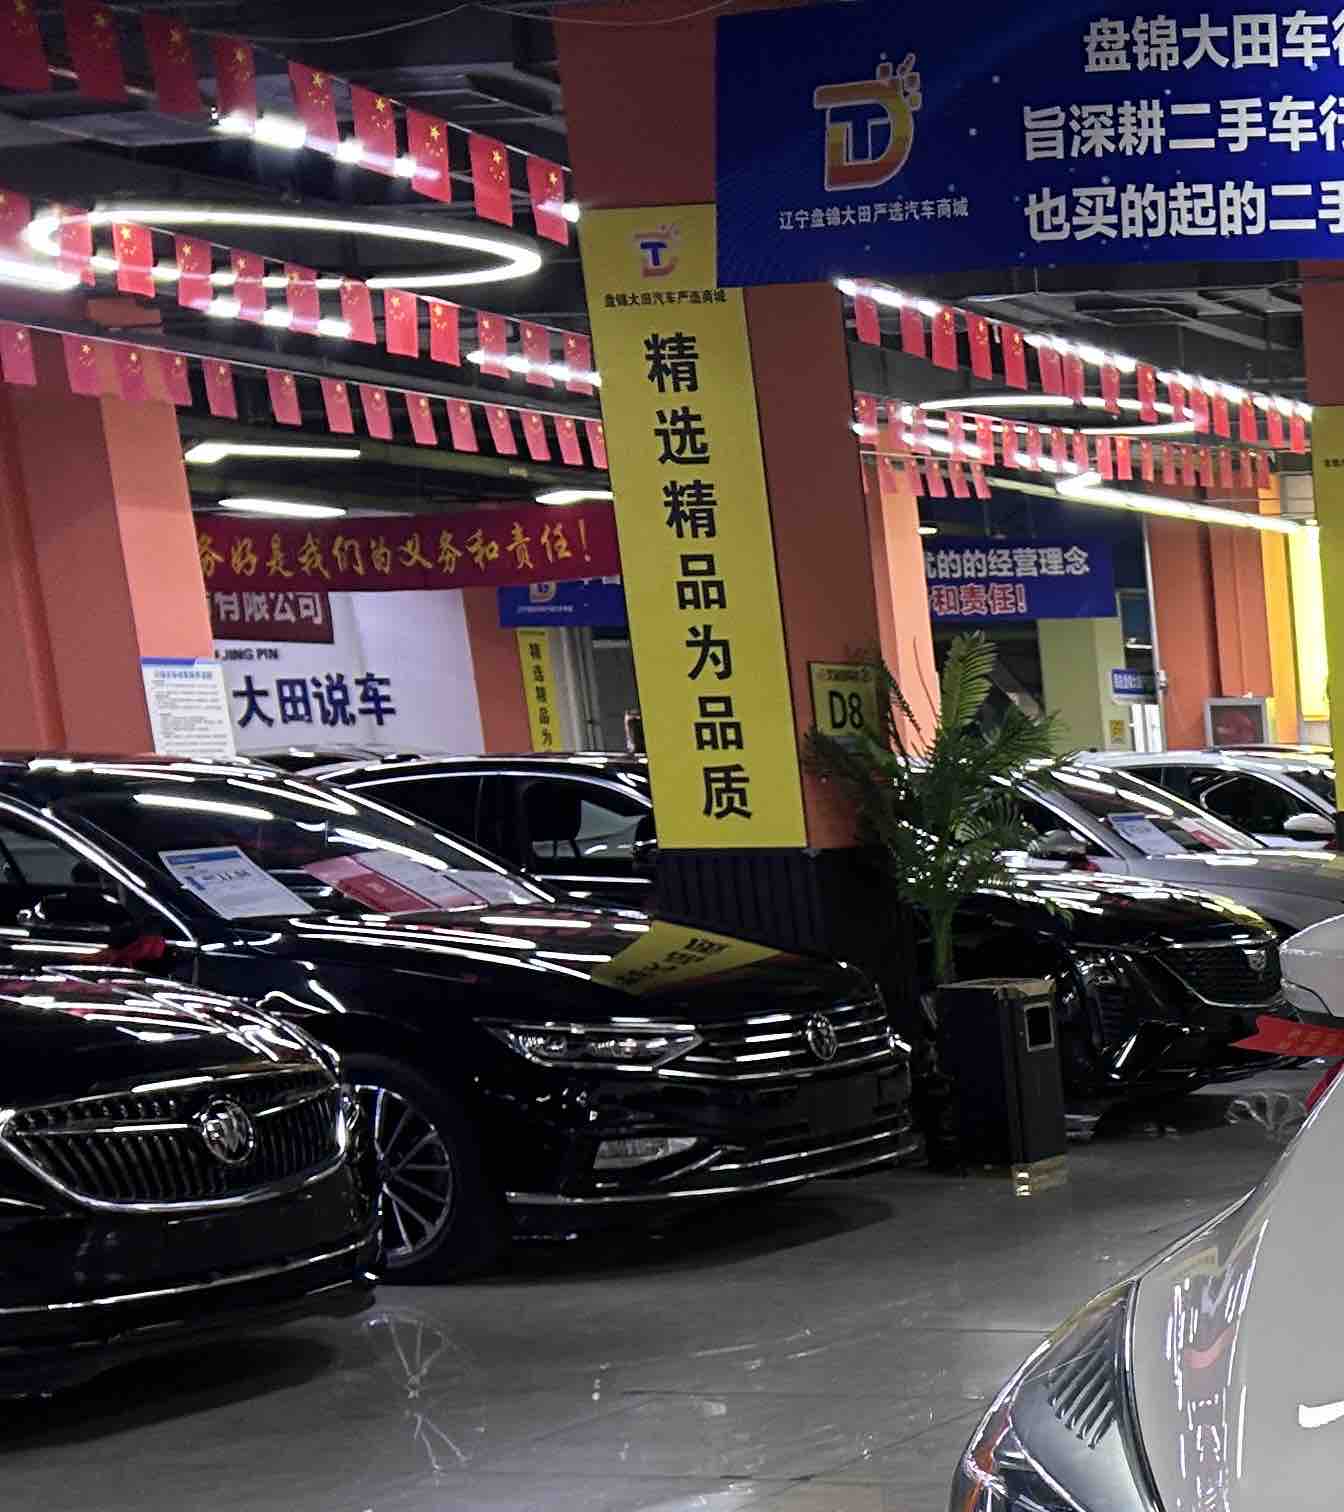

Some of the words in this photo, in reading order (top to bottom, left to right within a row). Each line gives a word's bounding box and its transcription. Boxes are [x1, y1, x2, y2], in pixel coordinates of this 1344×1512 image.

[779, 196, 970, 231] 辽宁盘锦大田严选汽车商城
[644, 331, 753, 821] 精选精品为品质
[208, 591, 323, 624] 有限公司
[929, 583, 1028, 616] 和责任！
[232, 671, 398, 729] 大田说车
[829, 690, 865, 729] D8
